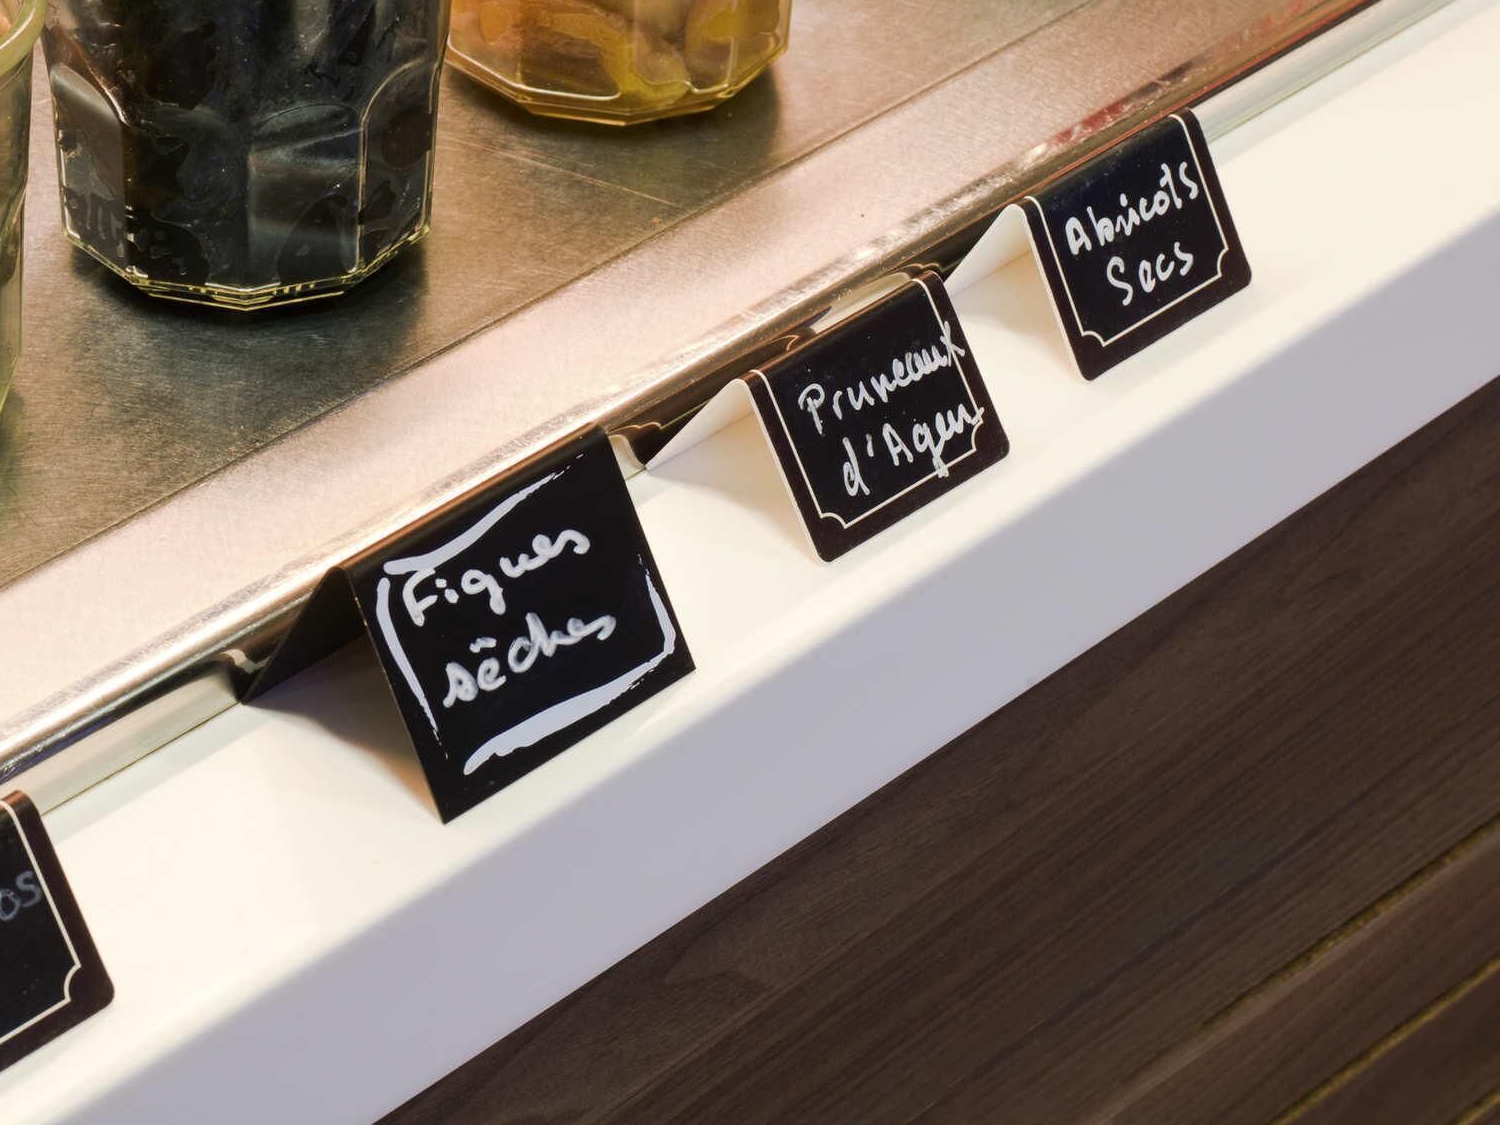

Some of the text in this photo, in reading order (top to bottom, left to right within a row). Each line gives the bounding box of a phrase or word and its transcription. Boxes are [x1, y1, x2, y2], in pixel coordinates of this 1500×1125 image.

[1064, 161, 1199, 255] Abricots
[1106, 241, 1194, 306] Secs
[798, 320, 965, 435] Pruneaux
[402, 528, 591, 627] Figues
